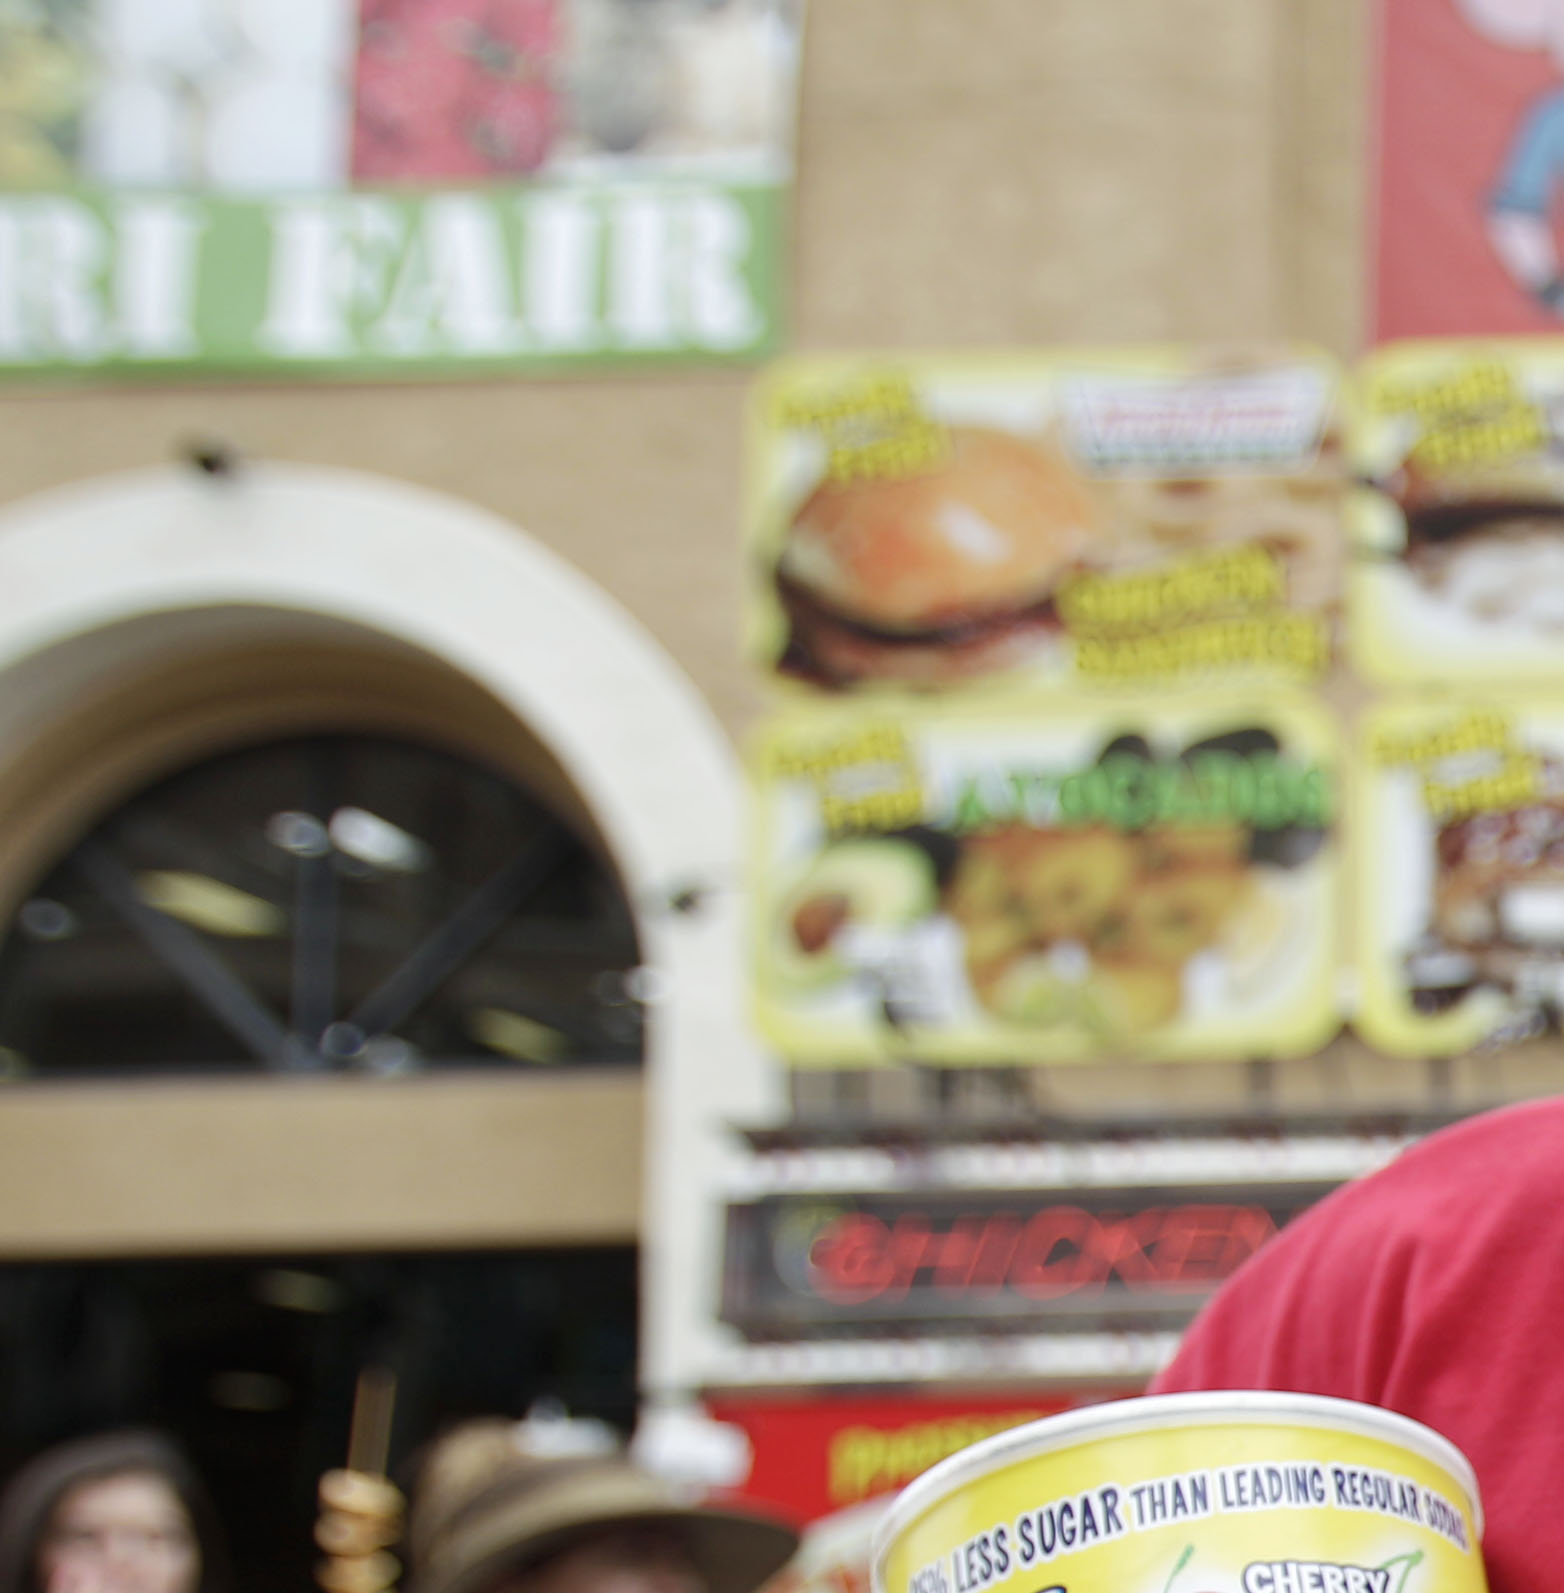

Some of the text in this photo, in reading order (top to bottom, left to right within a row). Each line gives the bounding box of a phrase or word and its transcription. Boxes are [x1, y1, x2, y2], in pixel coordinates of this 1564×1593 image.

[257, 186, 767, 355] FAIR
[1017, 1487, 1124, 1563] SUGAR
[1129, 1475, 1209, 1527] THAN
[1218, 1466, 1327, 1509] LEADING
[1331, 1466, 1423, 1524] REGULAR
